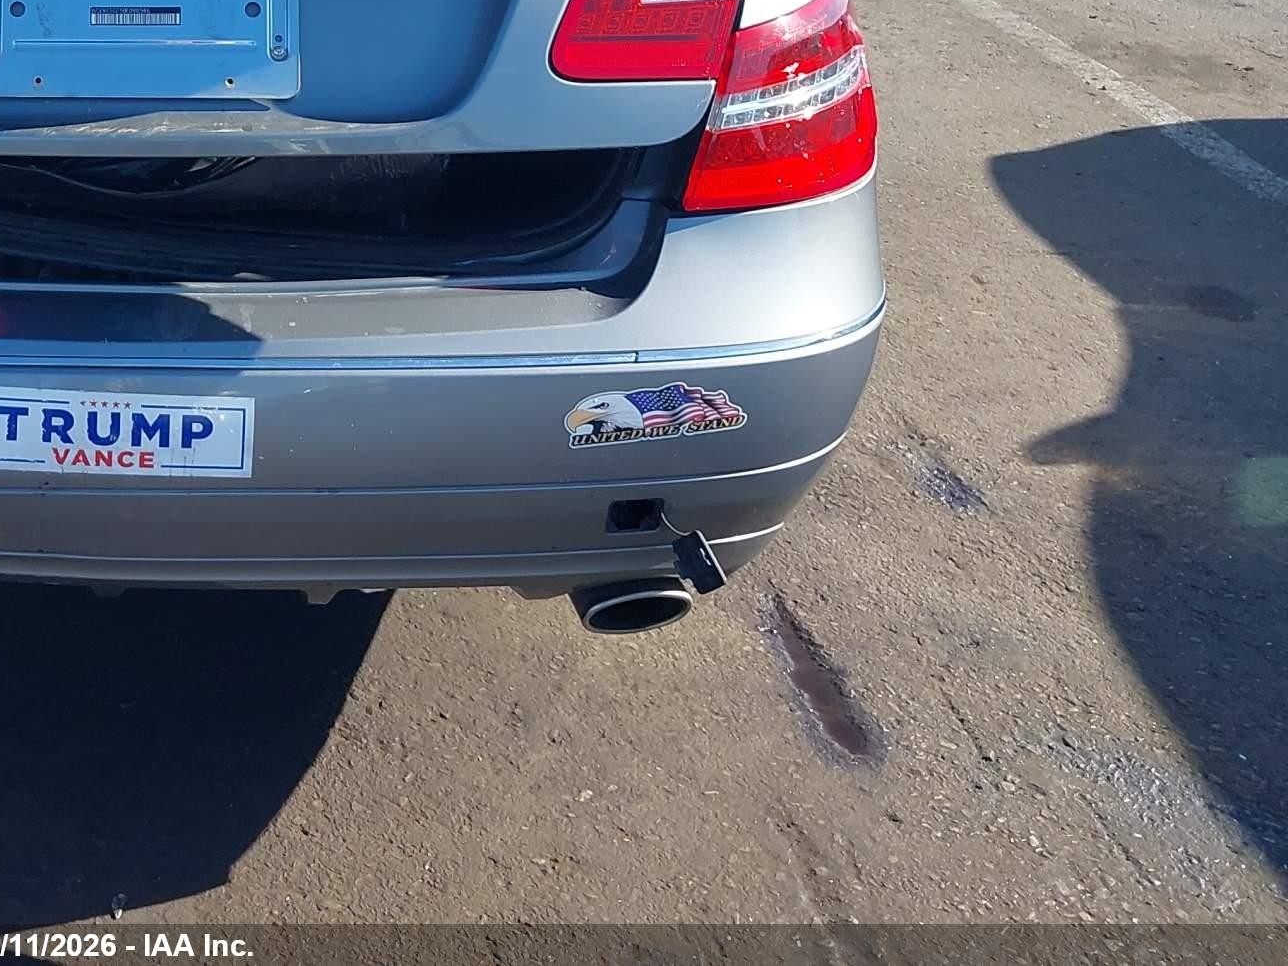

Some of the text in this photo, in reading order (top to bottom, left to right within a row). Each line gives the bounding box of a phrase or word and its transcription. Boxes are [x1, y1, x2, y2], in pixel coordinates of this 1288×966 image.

[574, 416, 744, 446] UNITED WE STAND
[52, 447, 155, 468] VANCE
